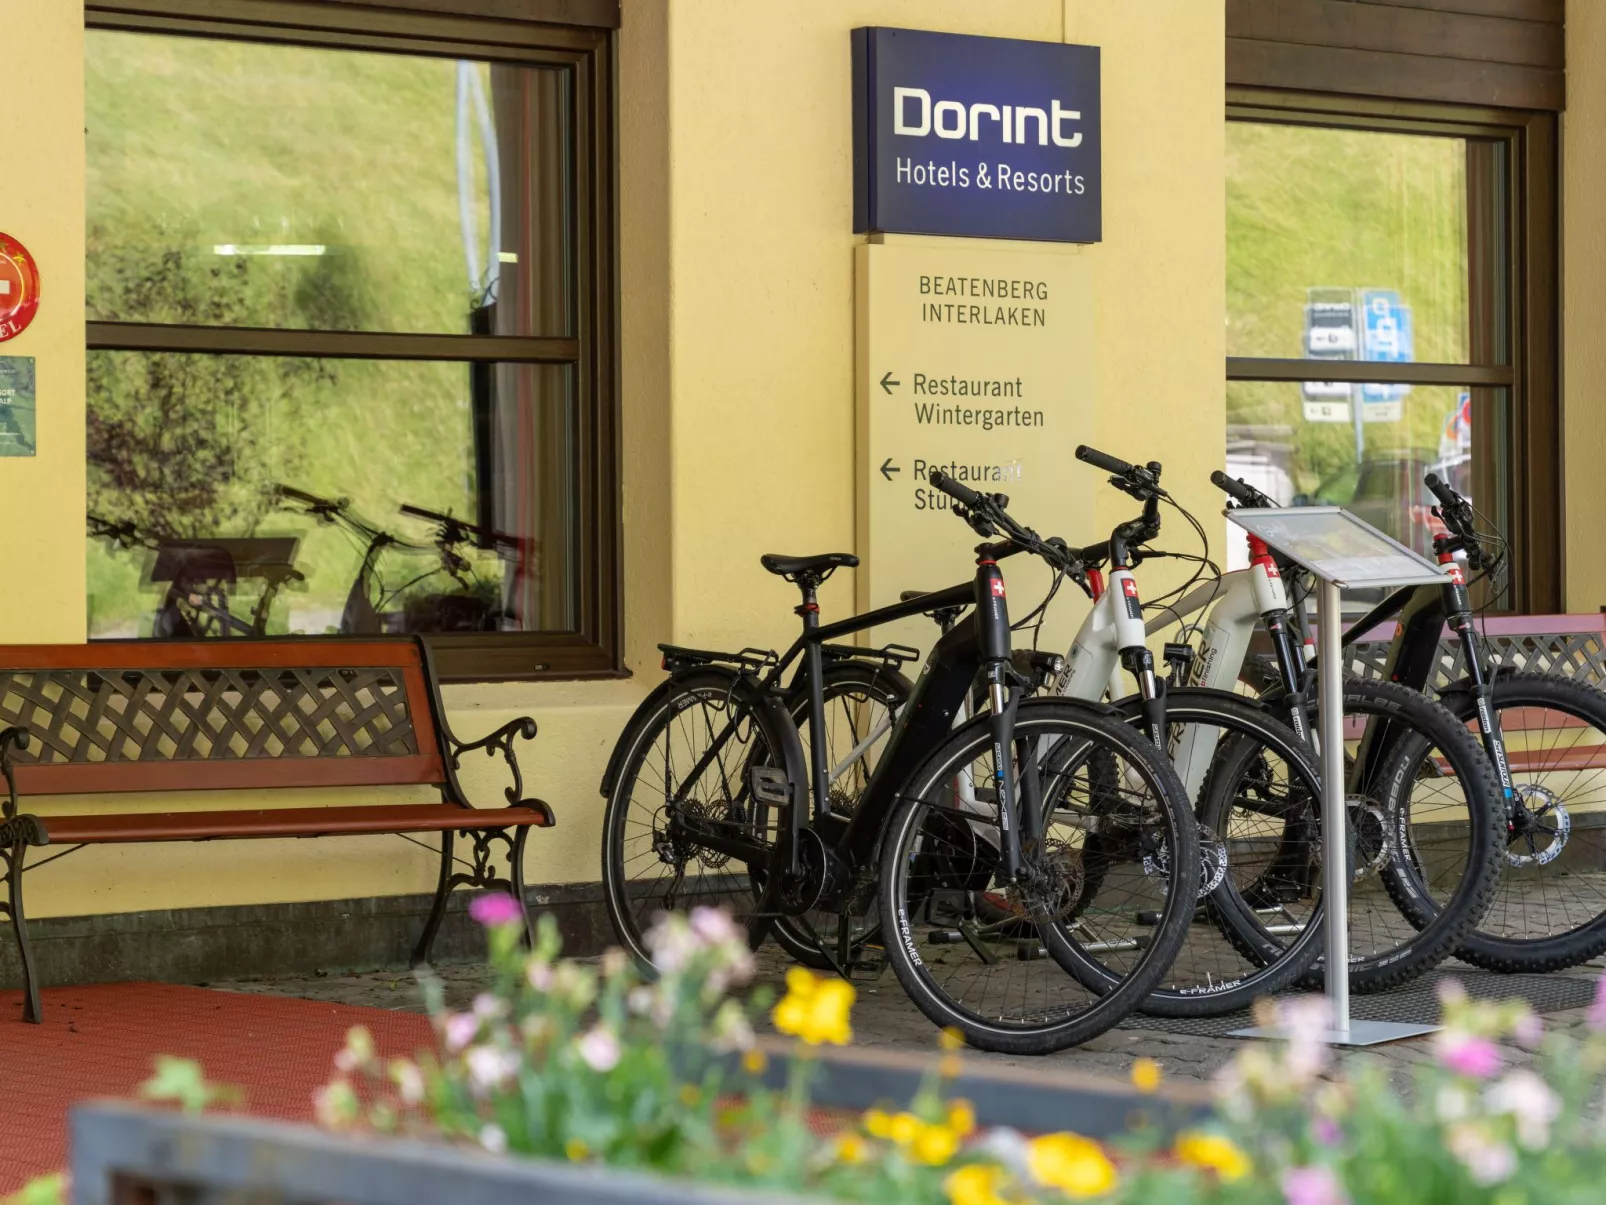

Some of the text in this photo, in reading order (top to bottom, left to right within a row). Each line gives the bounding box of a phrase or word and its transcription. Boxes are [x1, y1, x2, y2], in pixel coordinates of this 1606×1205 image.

[894, 87, 1083, 148] Dorint
[897, 157, 1085, 195] Hotels & Resorts
[919, 275, 1048, 300] BEATENBERG
[922, 303, 1045, 327] INTERLAKEN
[914, 373, 1022, 398] Restaurant
[914, 402, 1044, 431] Wintergarten
[898, 908, 923, 967] e-FRAMER
